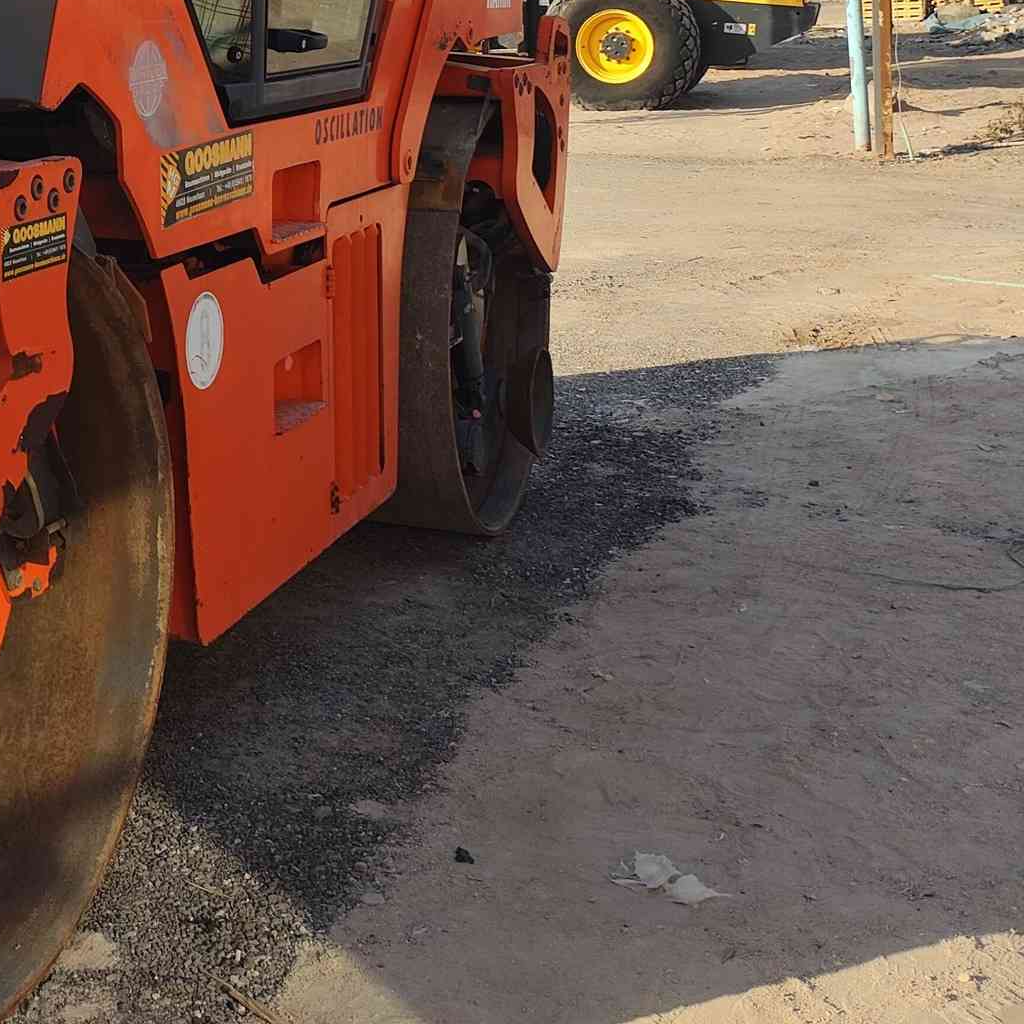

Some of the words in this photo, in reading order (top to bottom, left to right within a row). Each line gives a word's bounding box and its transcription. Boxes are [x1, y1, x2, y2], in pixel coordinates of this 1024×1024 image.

[315, 107, 384, 144] OSCILLATION
[184, 133, 252, 176] GOOSMANN
[12, 216, 66, 244] GOOSMANN
